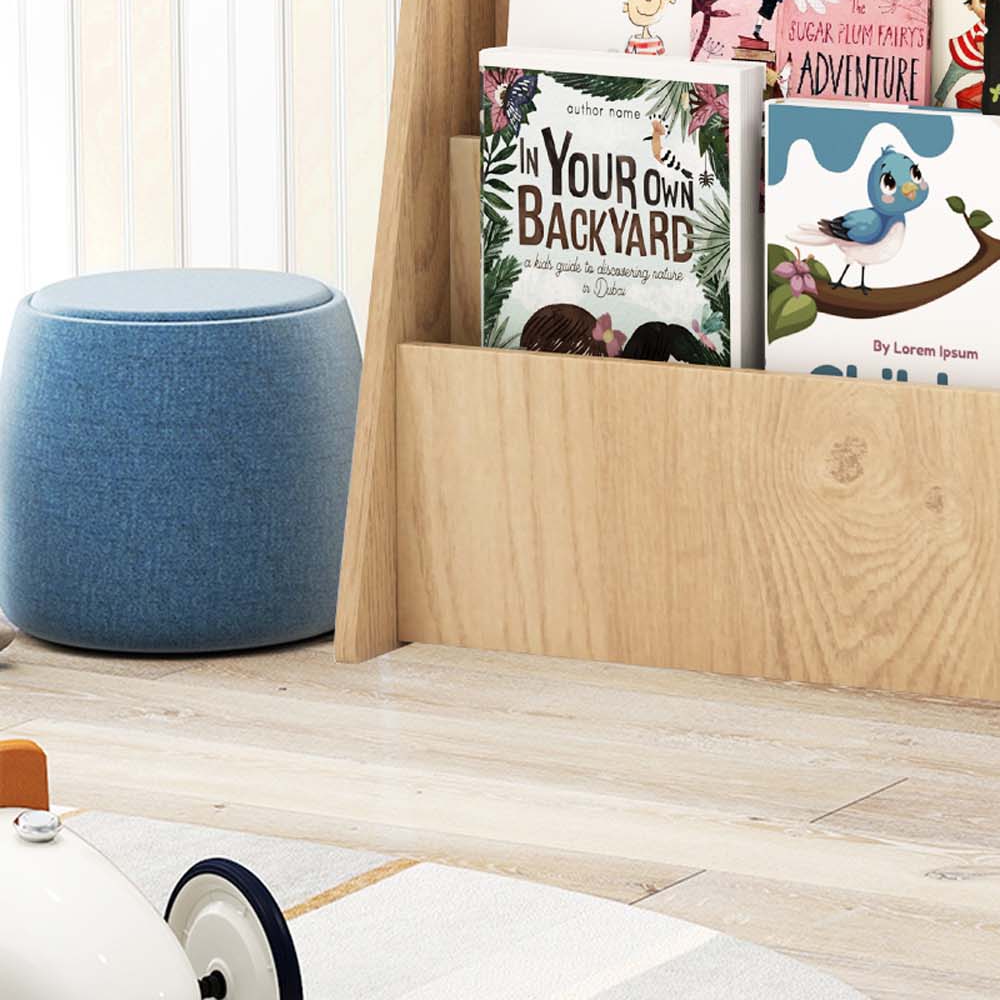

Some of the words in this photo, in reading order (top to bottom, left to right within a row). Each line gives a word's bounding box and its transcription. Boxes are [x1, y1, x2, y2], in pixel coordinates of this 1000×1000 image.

[788, 20, 834, 43] SUGAR
[838, 23, 873, 46] PLUM
[797, 50, 920, 102] ADVENTURE
[566, 101, 604, 116] author
[609, 106, 641, 120] name
[519, 136, 539, 177] IN
[541, 126, 638, 211] YOUR
[643, 168, 695, 211] OWN
[517, 184, 695, 264] BACKYARD
[523, 259, 532, 269] a
[555, 255, 583, 277] guide
[584, 260, 595, 274] to
[596, 258, 651, 285] discovering
[651, 266, 685, 282] nature
[873, 339, 890, 356] By
[893, 341, 936, 357] Lorem
[939, 343, 979, 361] Ipsum
